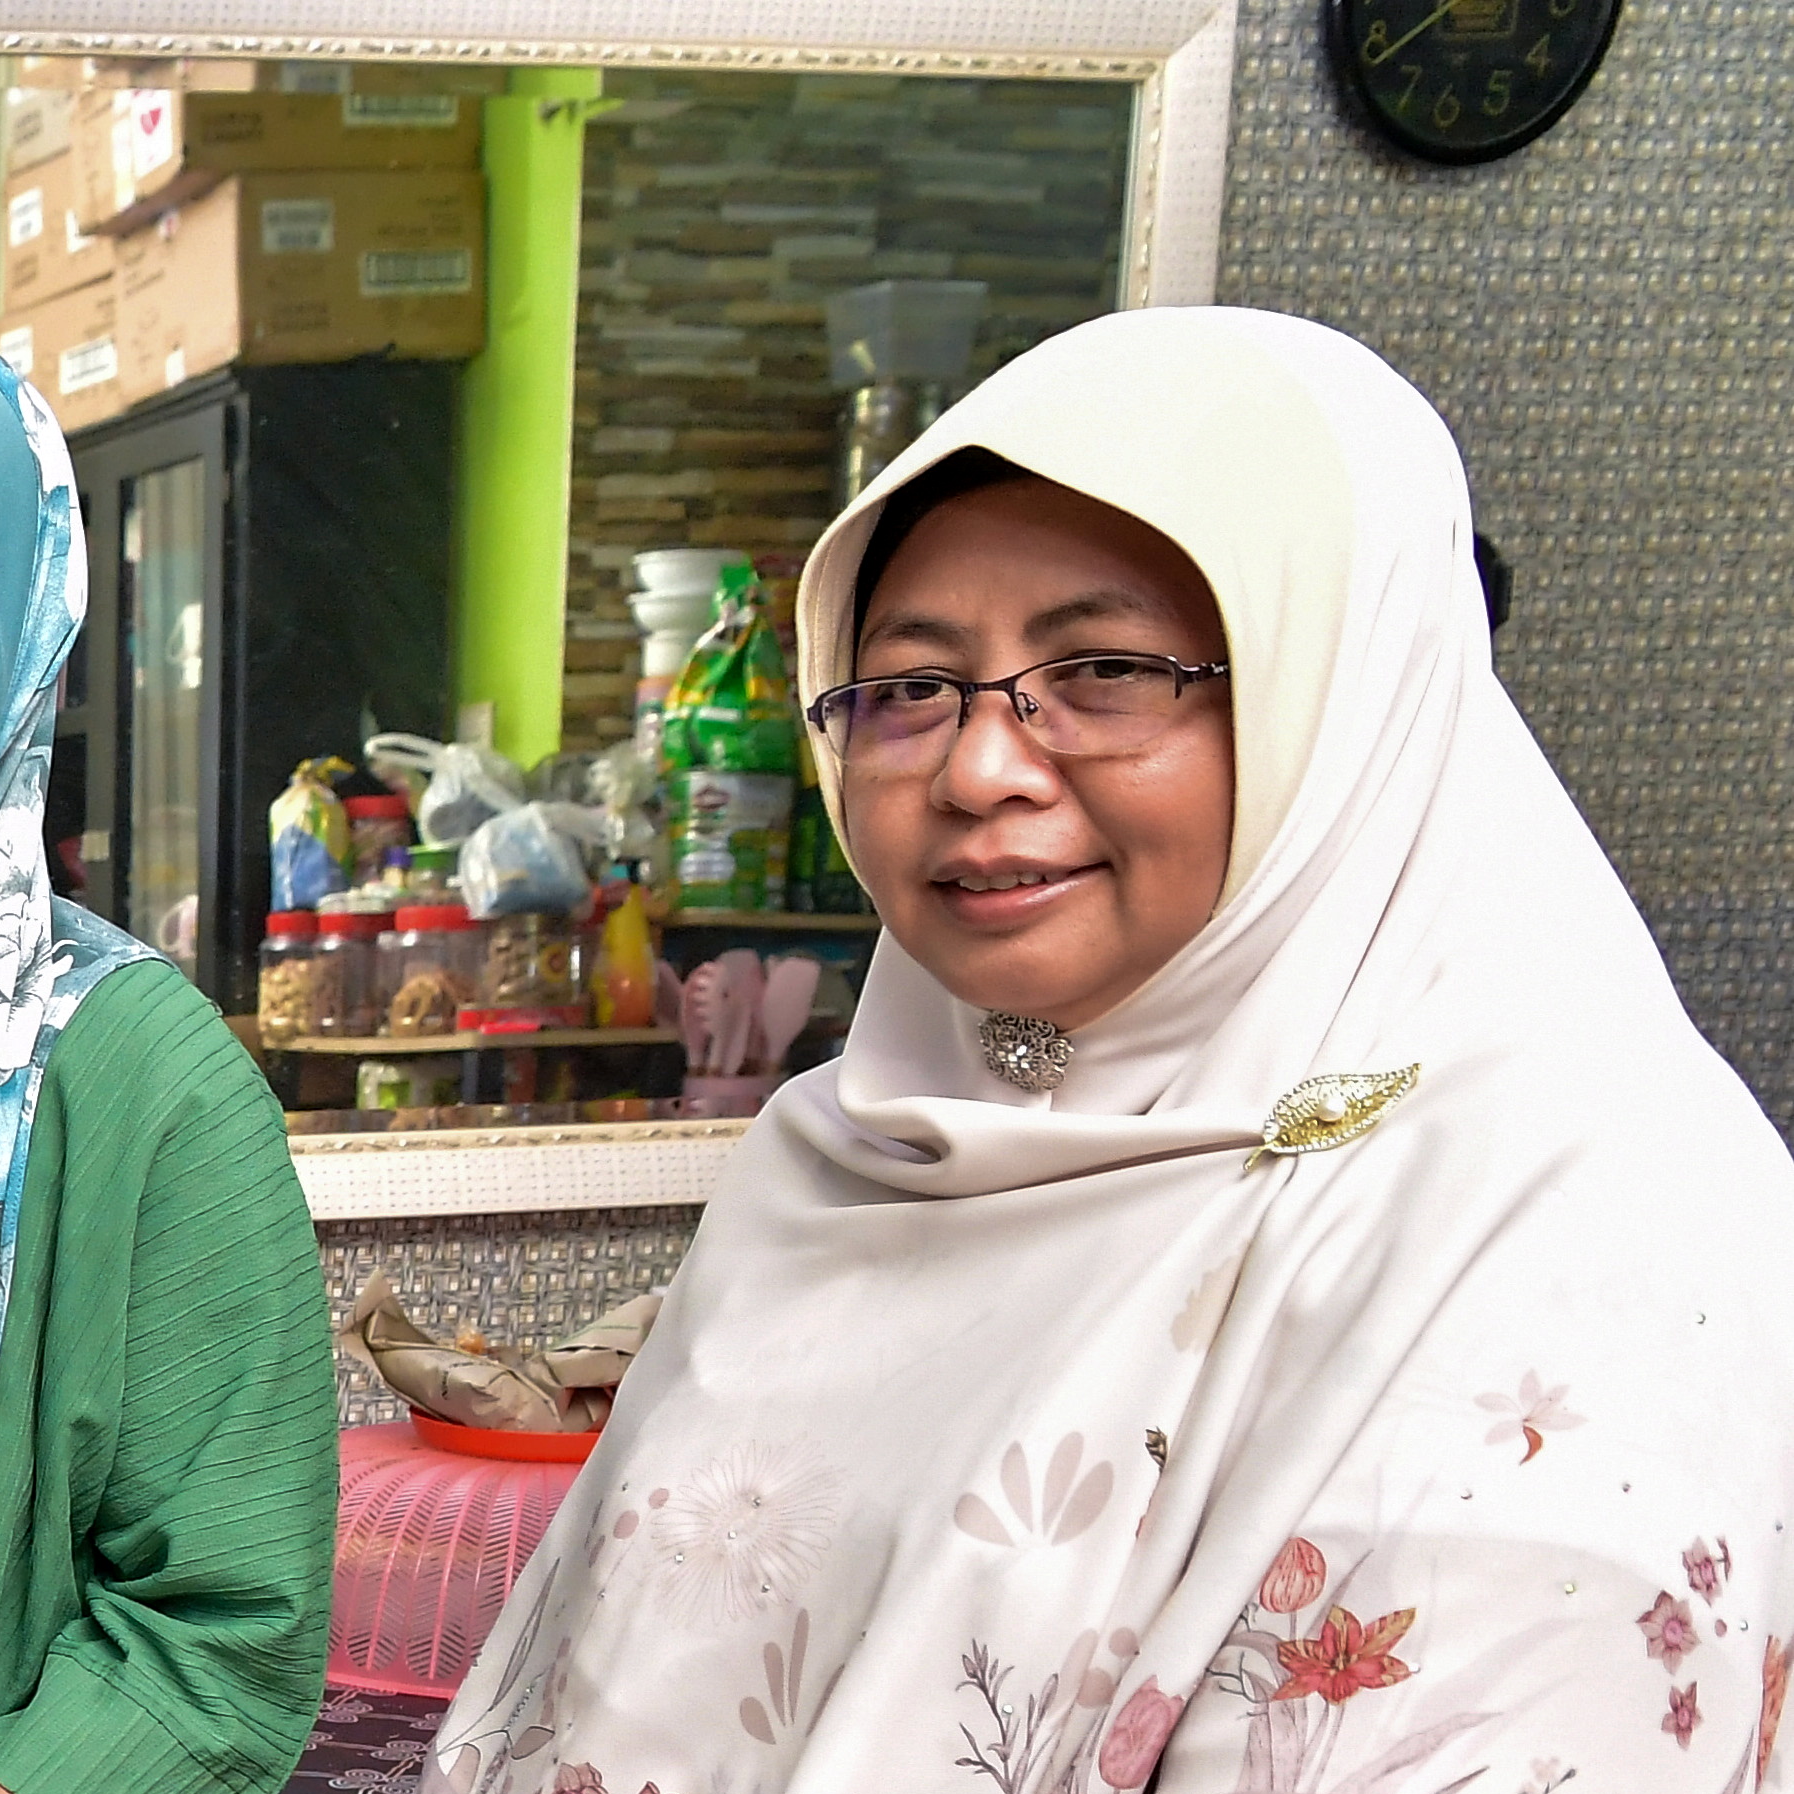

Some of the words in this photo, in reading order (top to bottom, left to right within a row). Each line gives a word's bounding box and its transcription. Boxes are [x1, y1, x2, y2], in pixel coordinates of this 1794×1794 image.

[1400, 65, 1423, 114] 7
[1434, 83, 1461, 131] 6
[1483, 69, 1513, 116] 5
